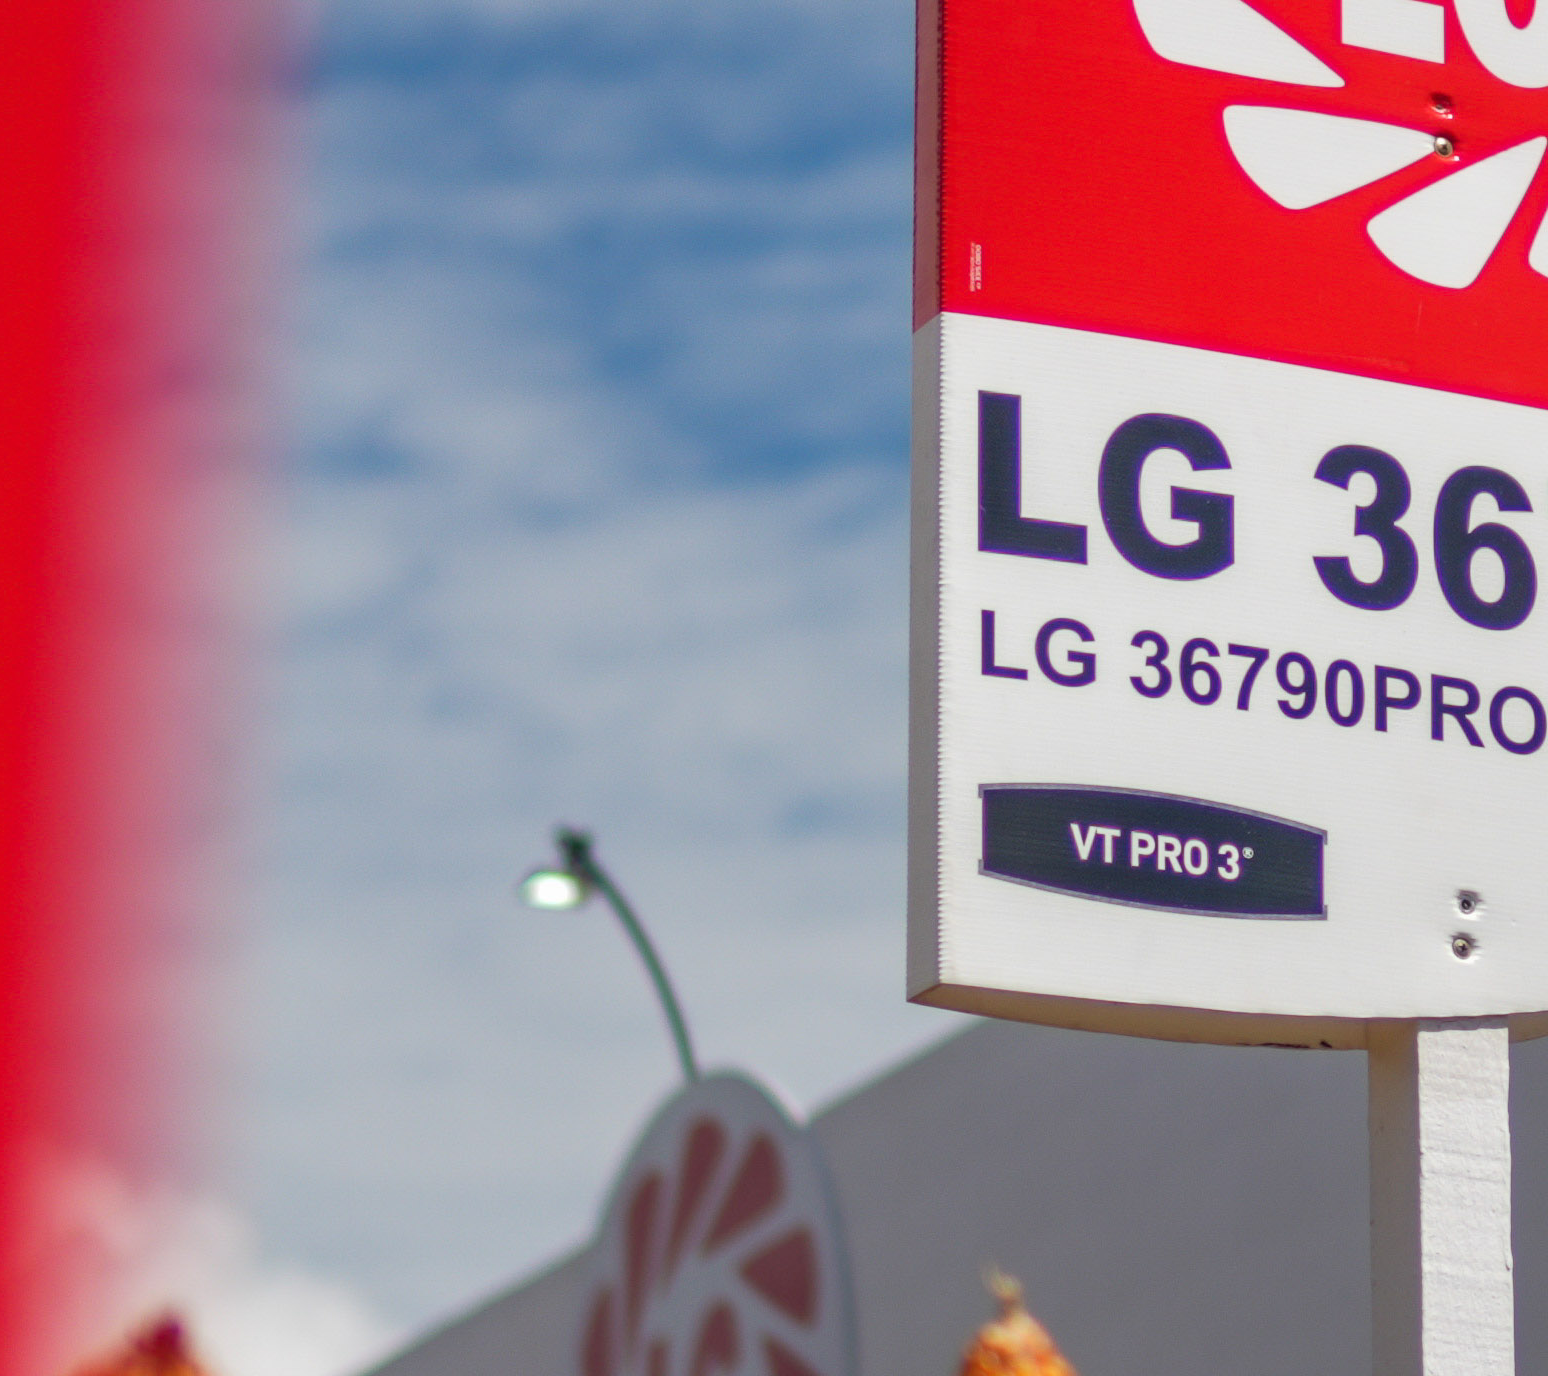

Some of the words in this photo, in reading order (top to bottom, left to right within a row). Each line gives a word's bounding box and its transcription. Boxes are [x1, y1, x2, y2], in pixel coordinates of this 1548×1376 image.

[977, 389, 1236, 581] LG
[979, 609, 1098, 688] LG
[1069, 822, 1122, 864] VT
[1130, 830, 1209, 876] PRO
